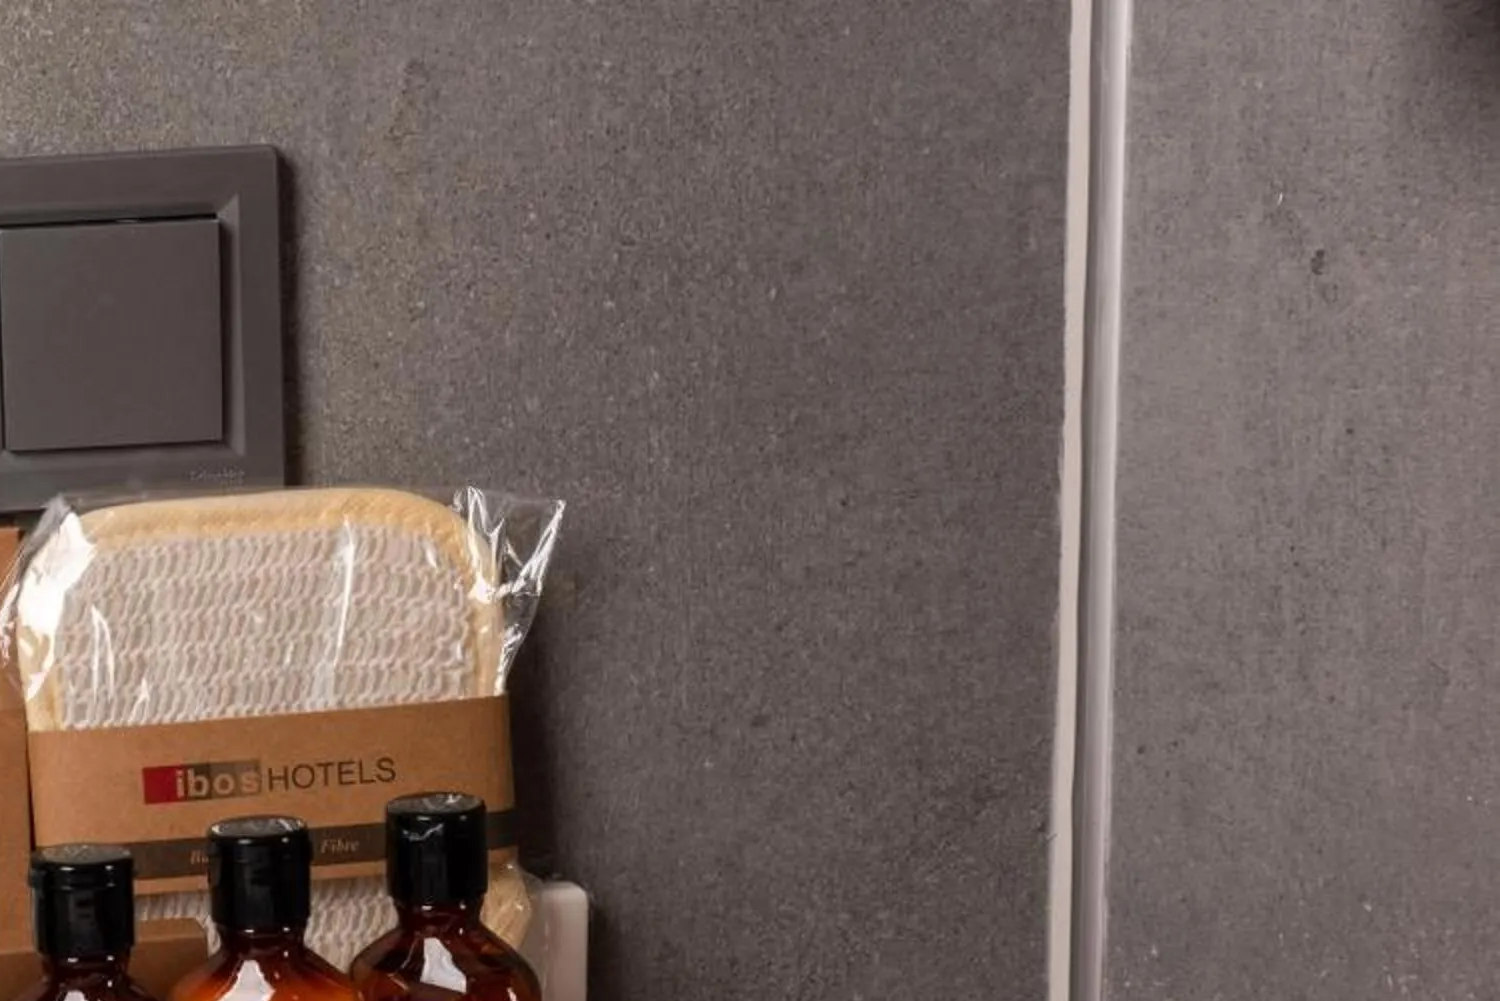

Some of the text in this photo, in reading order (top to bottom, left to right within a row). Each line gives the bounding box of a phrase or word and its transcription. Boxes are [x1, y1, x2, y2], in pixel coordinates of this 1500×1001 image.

[175, 757, 397, 798] ibos HOTELS
[320, 838, 360, 854] Fibre
